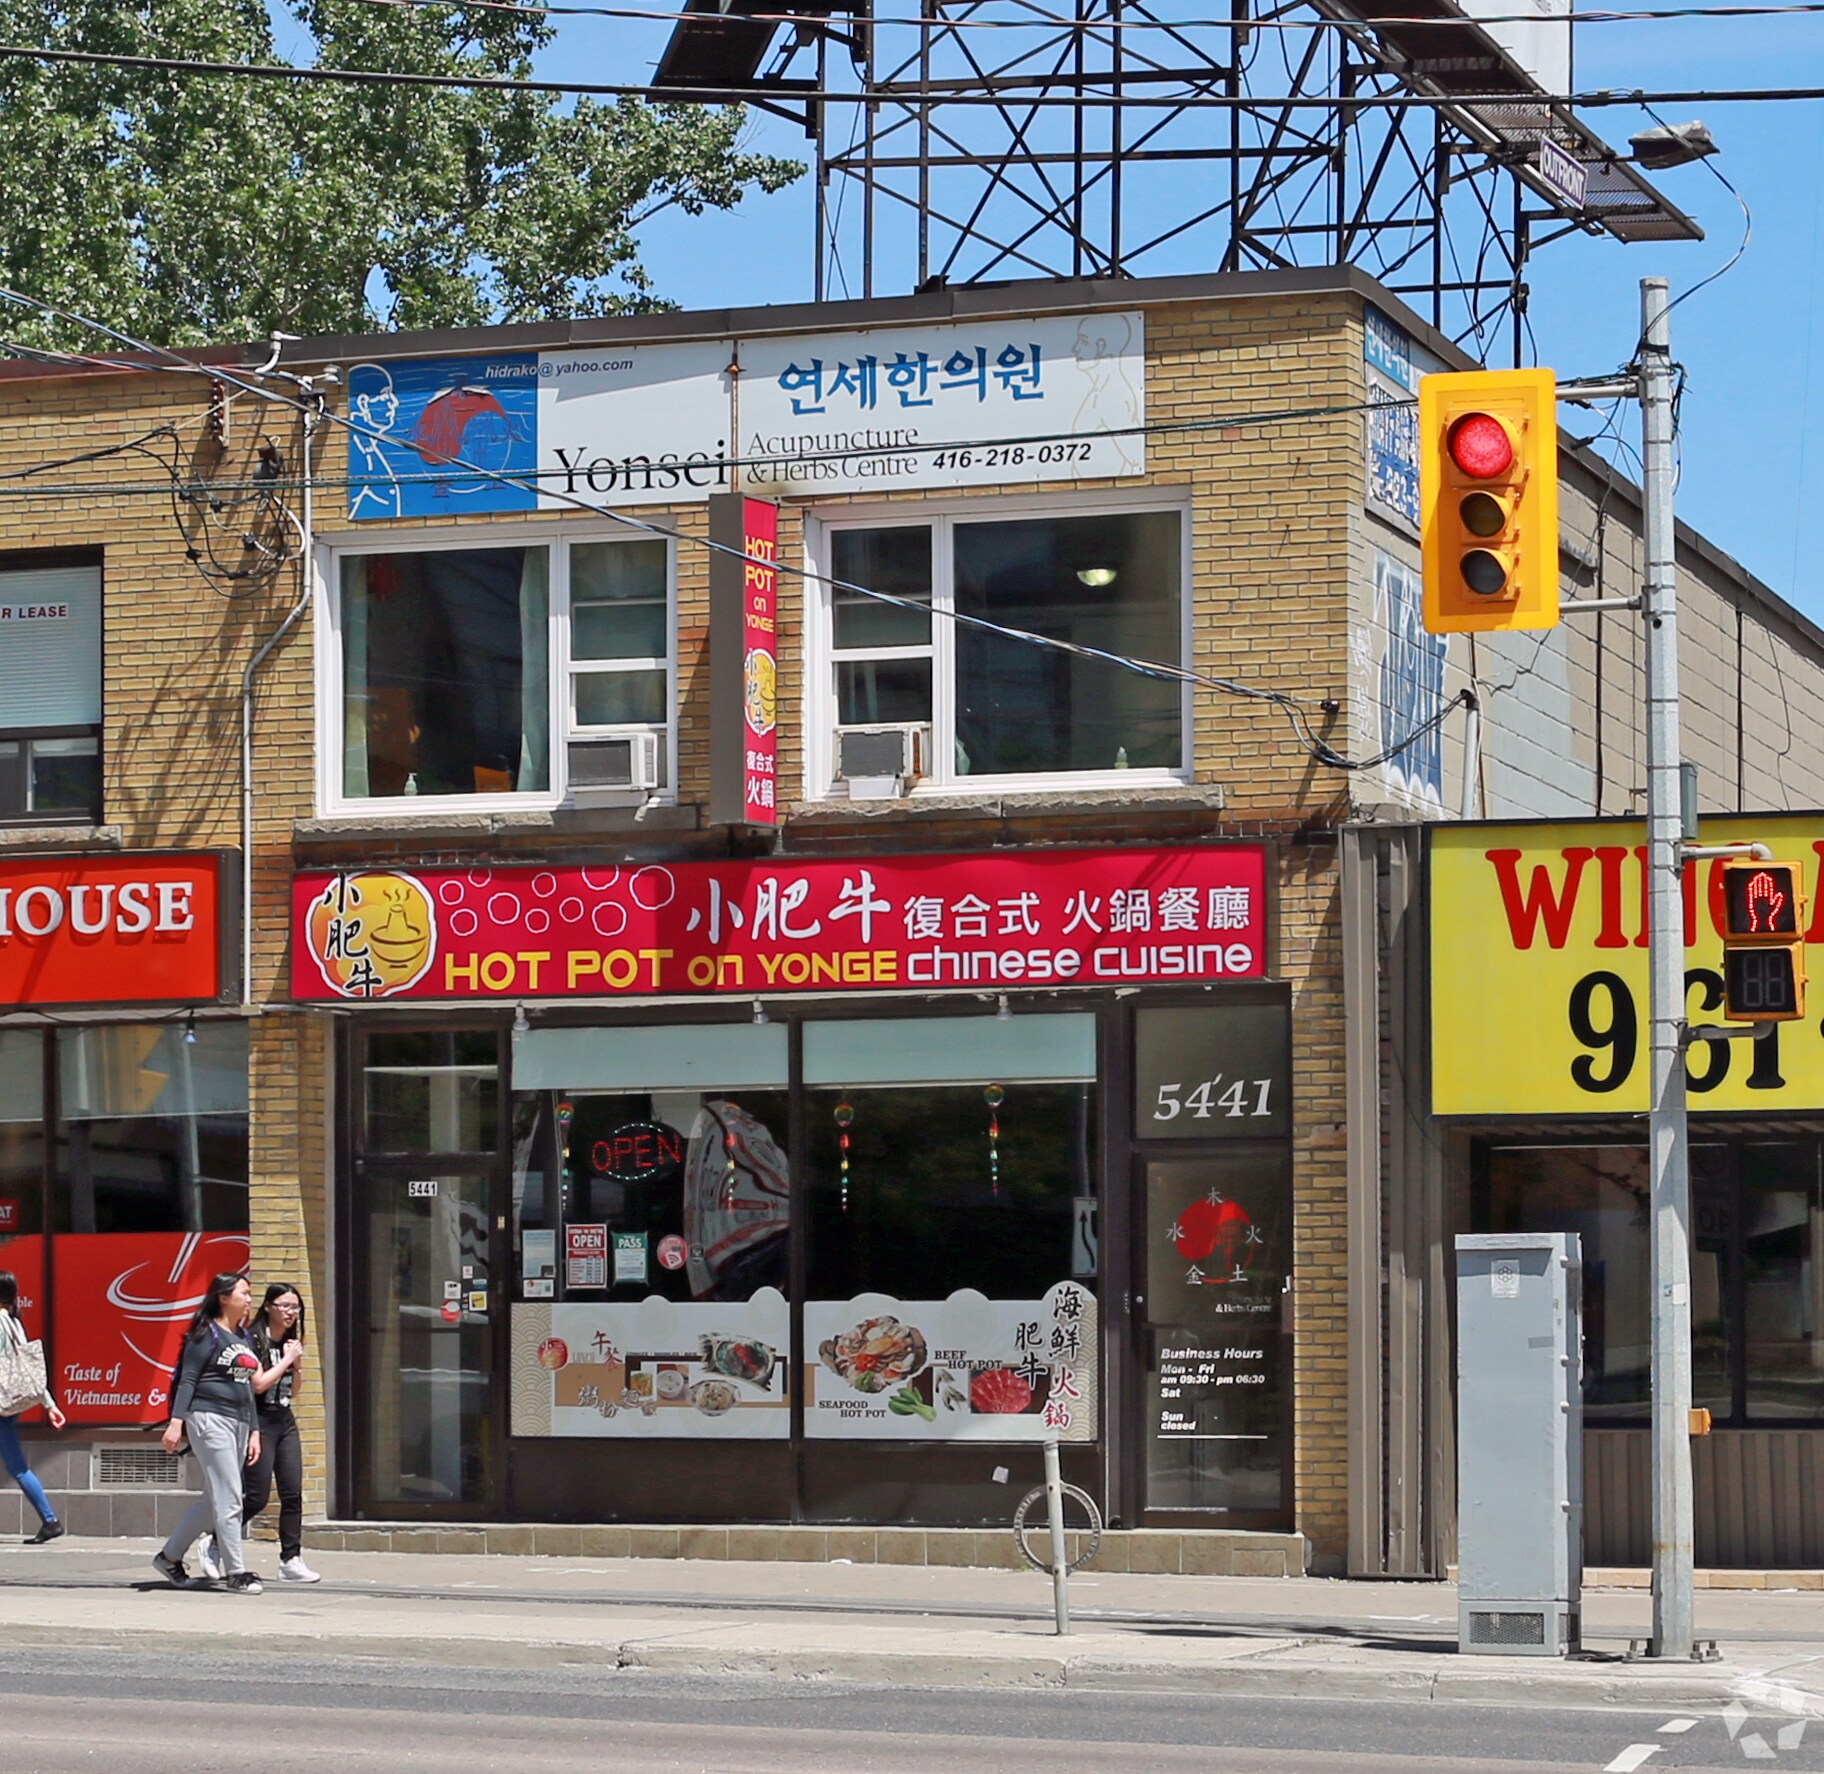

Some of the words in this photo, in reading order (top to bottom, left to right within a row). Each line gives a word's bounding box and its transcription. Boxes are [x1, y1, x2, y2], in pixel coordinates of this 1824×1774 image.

[778, 343, 1044, 416] 연세한의원
[747, 427, 919, 458] Acupuncture
[552, 439, 729, 494] Yonsei
[933, 443, 1092, 471] 416-218-0372
[747, 461, 768, 484] &
[772, 459, 838, 482] Herbs
[842, 455, 918, 479] Centre
[745, 535, 774, 562] HOT
[745, 565, 774, 592] POT
[18, 605, 68, 618] LEASE
[753, 596, 767, 612] on
[745, 613, 775, 633] YONGE
[0, 881, 194, 936] OUSE
[903, 891, 1040, 941] 復合式
[1061, 885, 1251, 935] 火鍋餐廳
[323, 871, 382, 997] 小肥牛
[445, 952, 551, 991] HOT
[567, 949, 674, 989] POT
[687, 954, 744, 987] on
[757, 950, 897, 985] YONGE
[592, 1133, 682, 1171] OPEN
[410, 1183, 436, 1195] 5441
[1207, 1186, 1225, 1207] 木
[572, 1235, 602, 1248] OPEN
[1166, 1222, 1186, 1243] 水
[1245, 1223, 1264, 1244] 火
[618, 1238, 642, 1248] PASS
[1185, 1264, 1206, 1285] 金
[1228, 1263, 1249, 1283] 土
[934, 1350, 967, 1360] BEEF
[1160, 1348, 1221, 1359] Business
[1223, 1348, 1264, 1359] Hours
[64, 1363, 102, 1381] Taste
[105, 1362, 122, 1388] of
[948, 1360, 977, 1370] HOT
[978, 1360, 1003, 1370] POT
[1160, 1364, 1186, 1374] Mon
[1198, 1363, 1215, 1374] Fri
[1160, 1376, 1177, 1384] am
[1179, 1374, 1209, 1384] 09:30
[1215, 1376, 1234, 1386] pm
[1235, 1374, 1265, 1384] 06:30
[64, 1389, 141, 1405] Vietnamese
[148, 1388, 167, 1406] &
[1160, 1387, 1181, 1398] Sat
[818, 1401, 868, 1409] SEAFOOD
[840, 1410, 864, 1418] HOT
[865, 1410, 887, 1418] POT
[1160, 1411, 1184, 1421] Sun
[1160, 1421, 1197, 1431] closed
